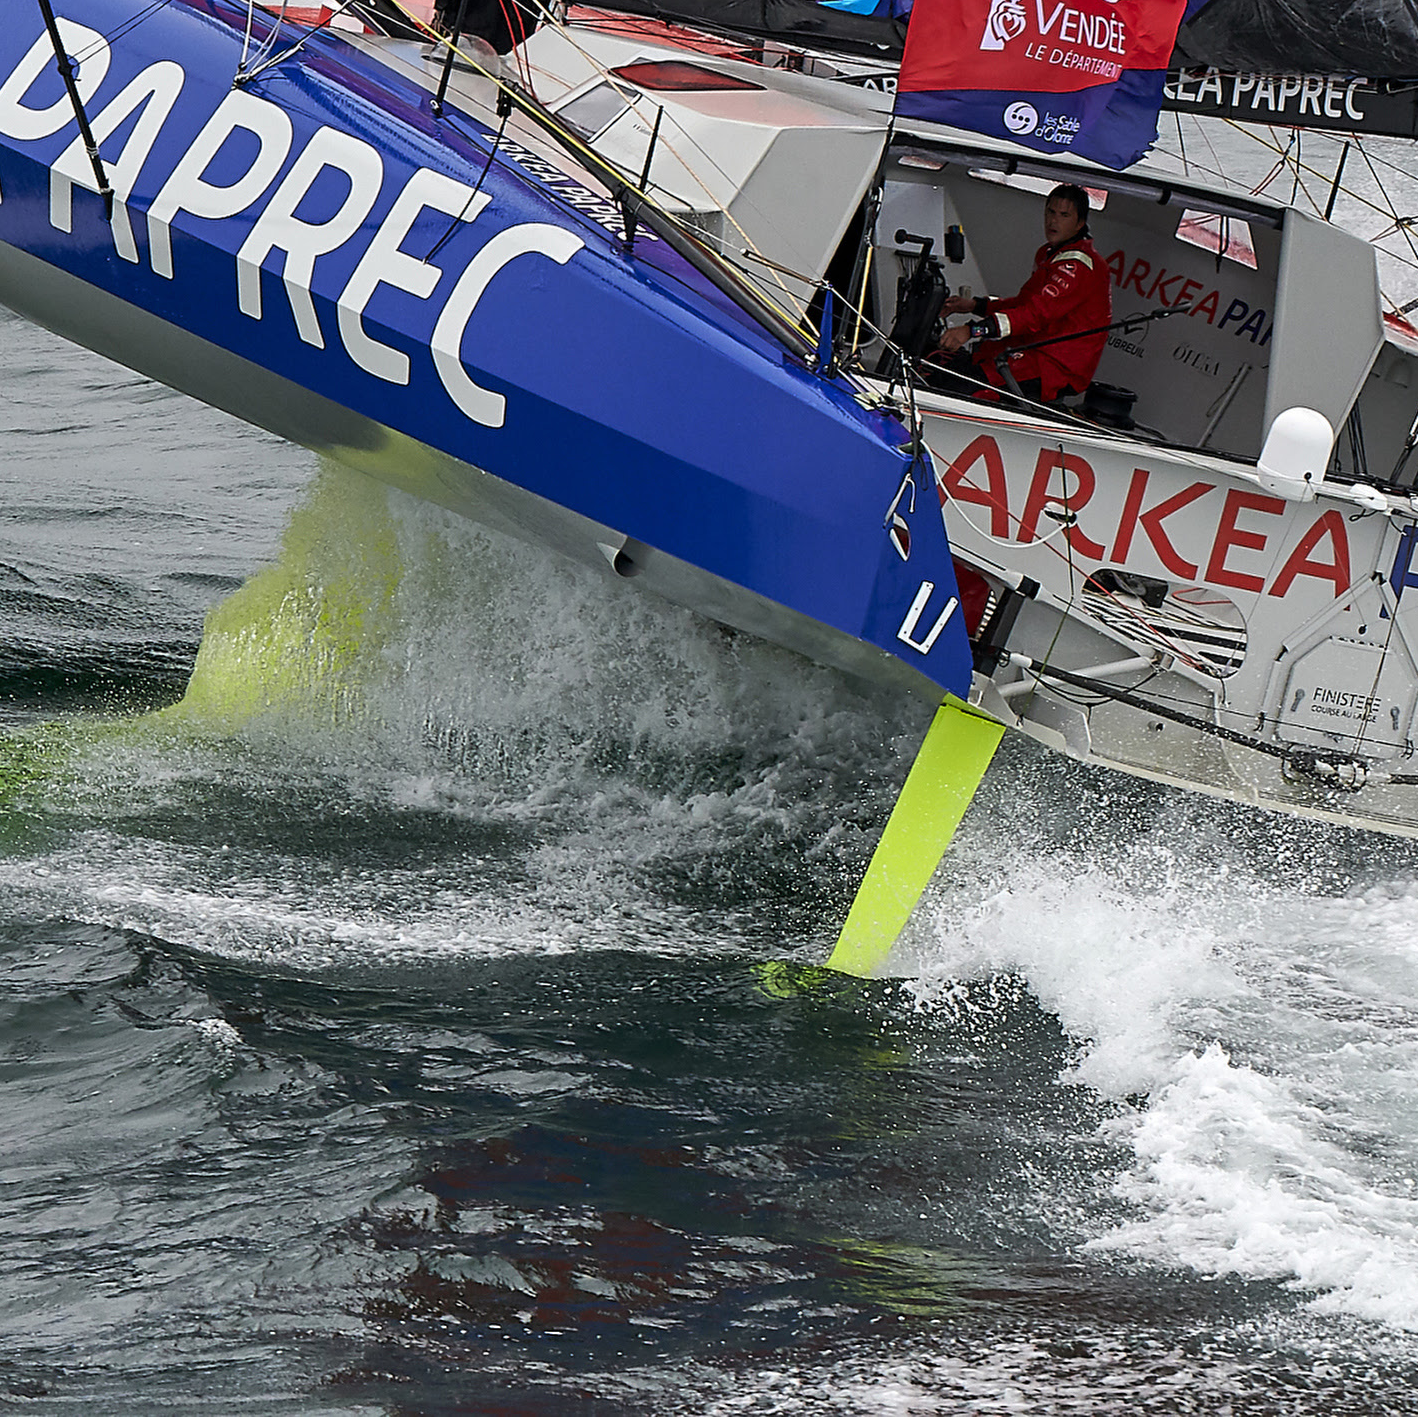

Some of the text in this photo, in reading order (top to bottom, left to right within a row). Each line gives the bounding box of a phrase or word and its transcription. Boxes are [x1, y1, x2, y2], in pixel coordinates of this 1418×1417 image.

[1025, 42, 1047, 61] LE
[1231, 71, 1368, 121] PAPREC
[481, 132, 570, 183] ARKEA
[1105, 249, 1220, 325] ARKEA
[1107, 334, 1145, 359] UBREUIL
[937, 434, 1351, 602] ARKEA
[1310, 704, 1340, 717] COURSE
[1341, 710, 1352, 719] AU
